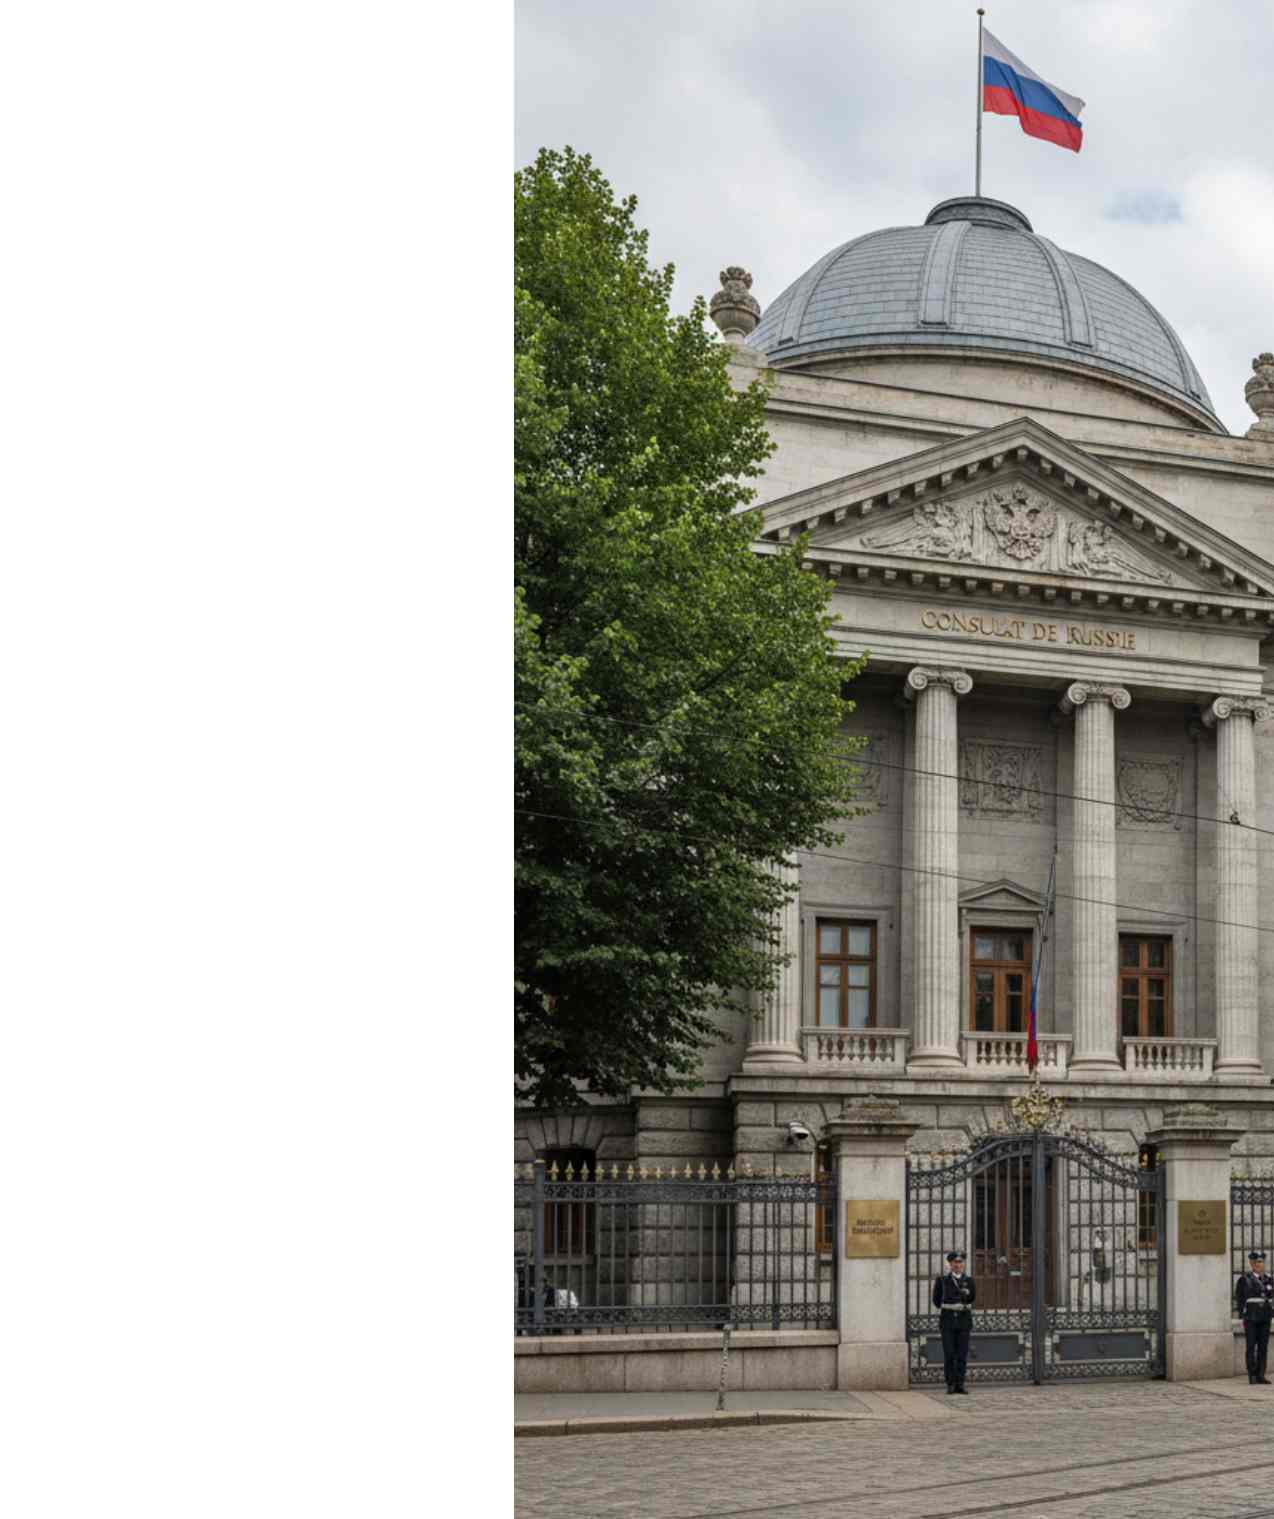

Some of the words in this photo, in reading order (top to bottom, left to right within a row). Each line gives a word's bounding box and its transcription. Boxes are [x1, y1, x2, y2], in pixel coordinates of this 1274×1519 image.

[921, 611, 1024, 640] CONSULAT
[1032, 623, 1057, 642] DE
[1066, 625, 1137, 650] RUSSIE
